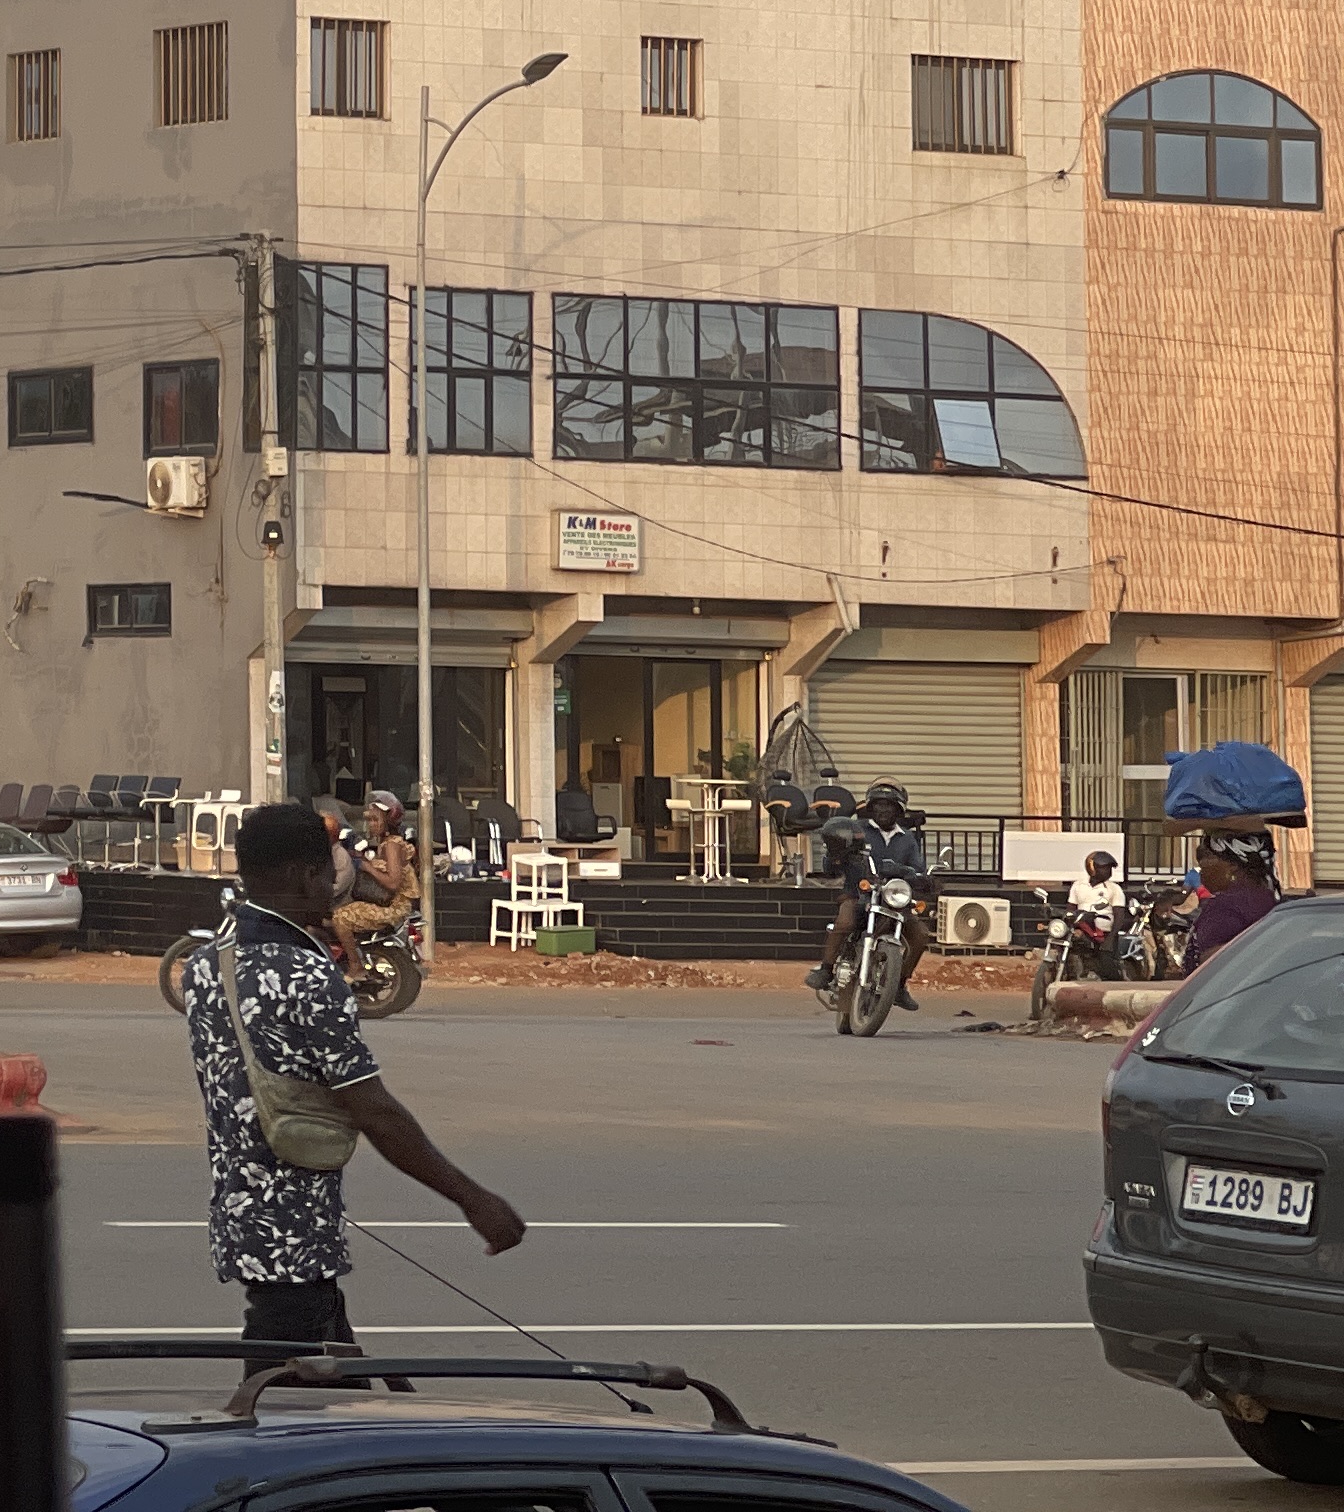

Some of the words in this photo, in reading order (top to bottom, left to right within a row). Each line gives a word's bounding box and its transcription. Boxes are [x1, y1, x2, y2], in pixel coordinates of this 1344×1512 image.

[599, 520, 632, 532] Store
[1205, 1174, 1265, 1212] 1289
[1278, 1182, 1311, 1217] BJ
